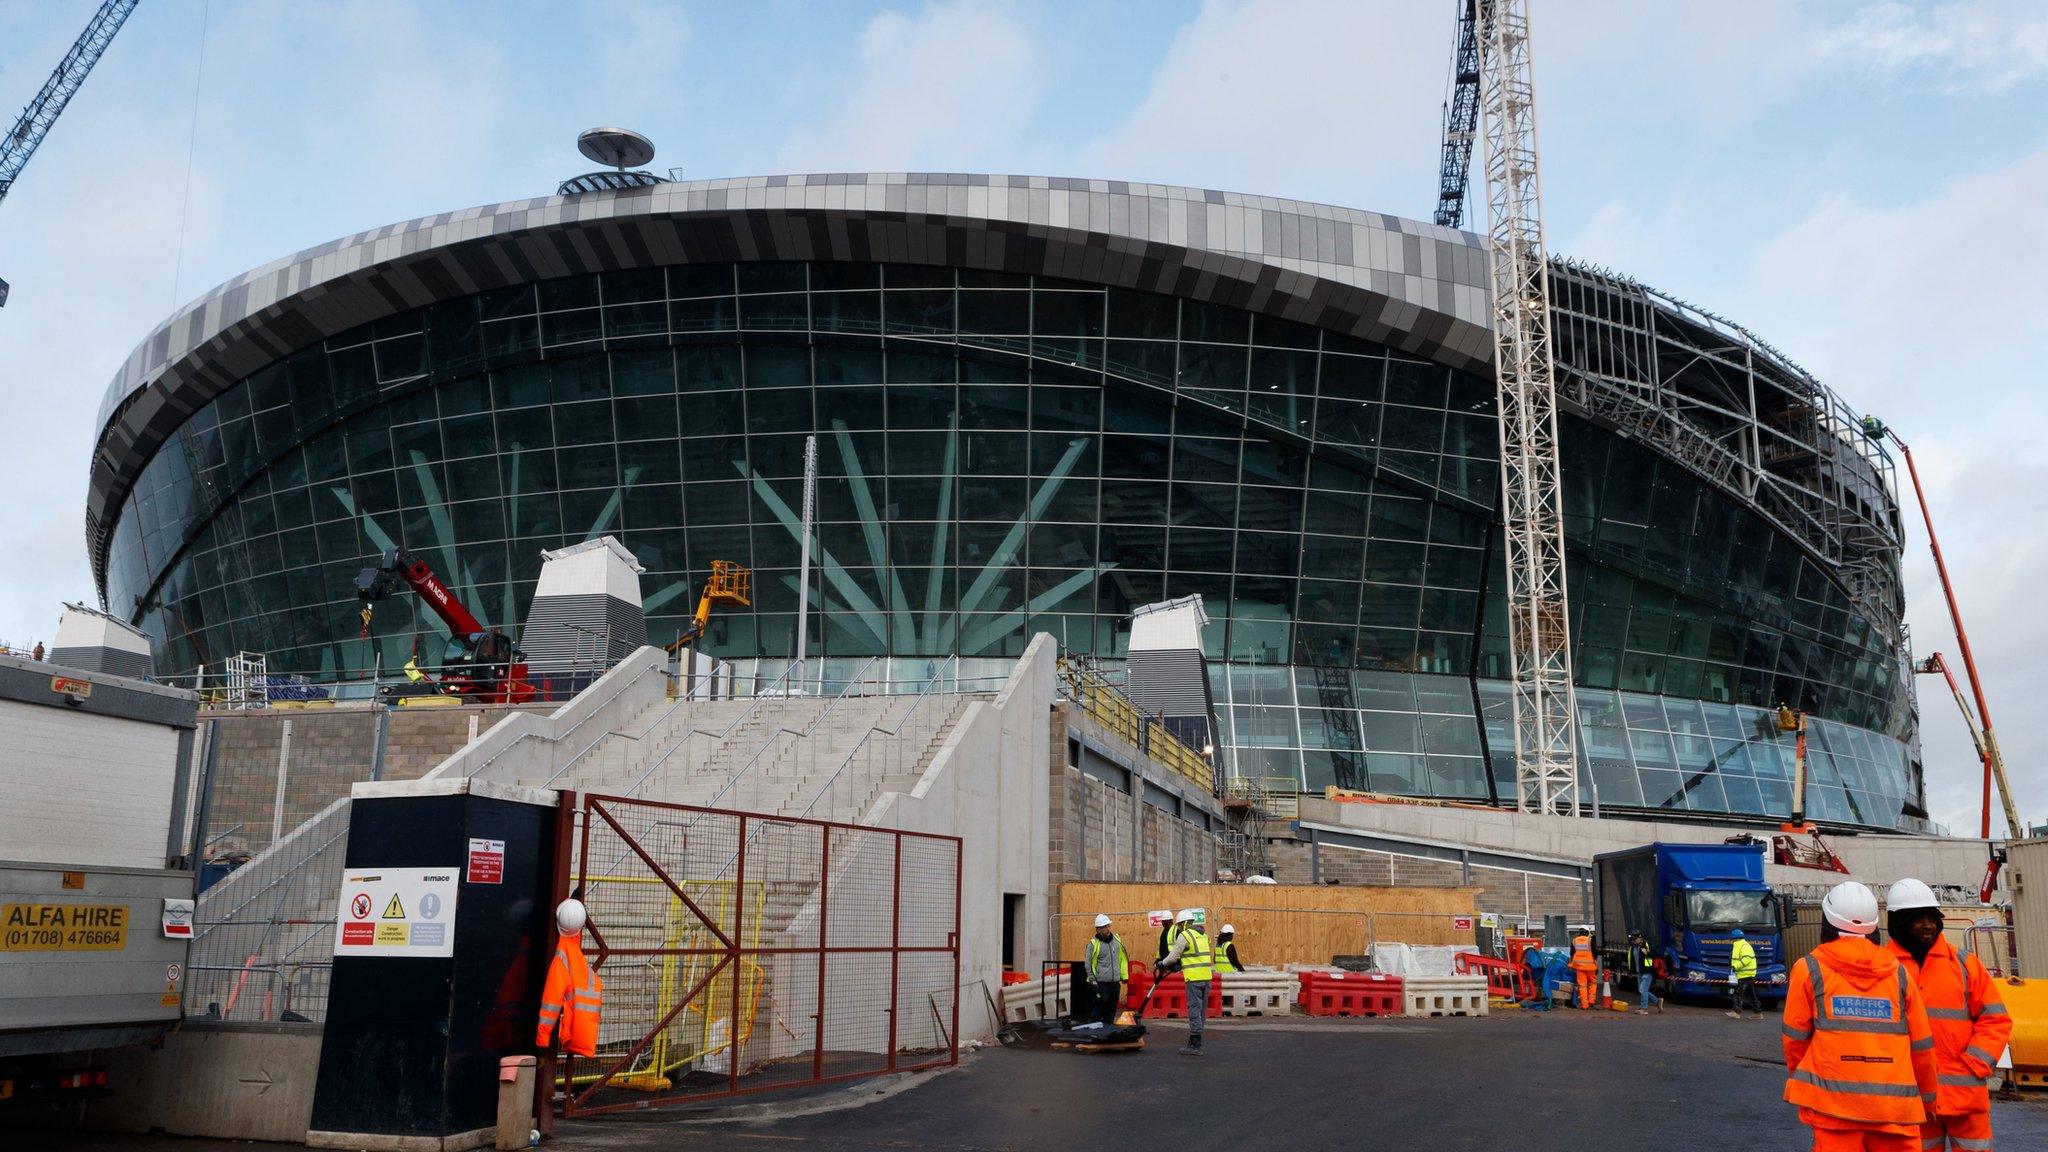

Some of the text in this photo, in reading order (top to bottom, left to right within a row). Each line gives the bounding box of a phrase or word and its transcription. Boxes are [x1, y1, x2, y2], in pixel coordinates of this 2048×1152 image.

[427, 579, 449, 605] MAGNI
[8, 907, 123, 926] ALFA HIRE
[5, 931, 120, 948] (01708) 476664
[1839, 998, 1885, 1008] TRAFFIC
[1834, 1007, 1890, 1017] MARSHAL
